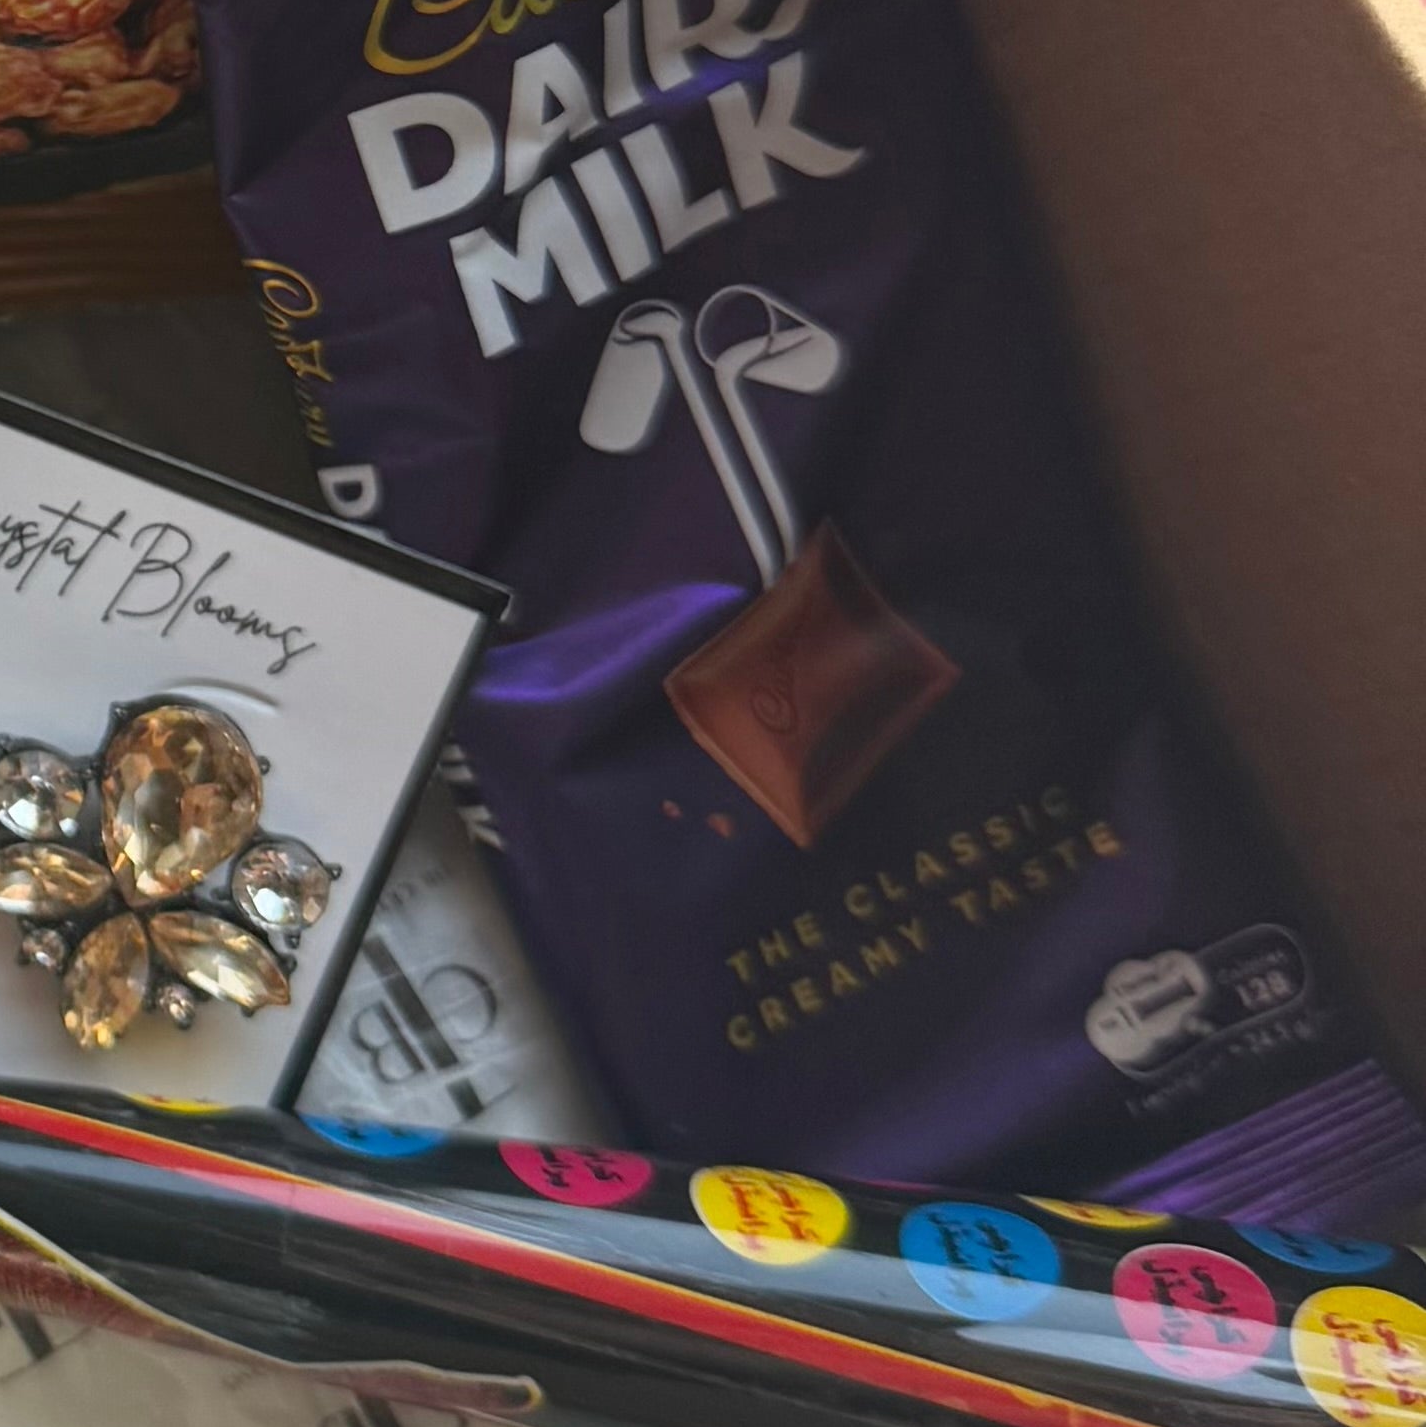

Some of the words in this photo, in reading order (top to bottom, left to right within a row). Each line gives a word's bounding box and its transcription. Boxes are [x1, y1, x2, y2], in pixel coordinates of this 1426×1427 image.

[449, 52, 866, 360] MILK
[102, 523, 317, 675] Blooms
[726, 912, 824, 984] THE
[844, 785, 1071, 920] CLASSIC
[727, 917, 927, 1049] CREAMY
[951, 821, 1124, 924] TASTE
